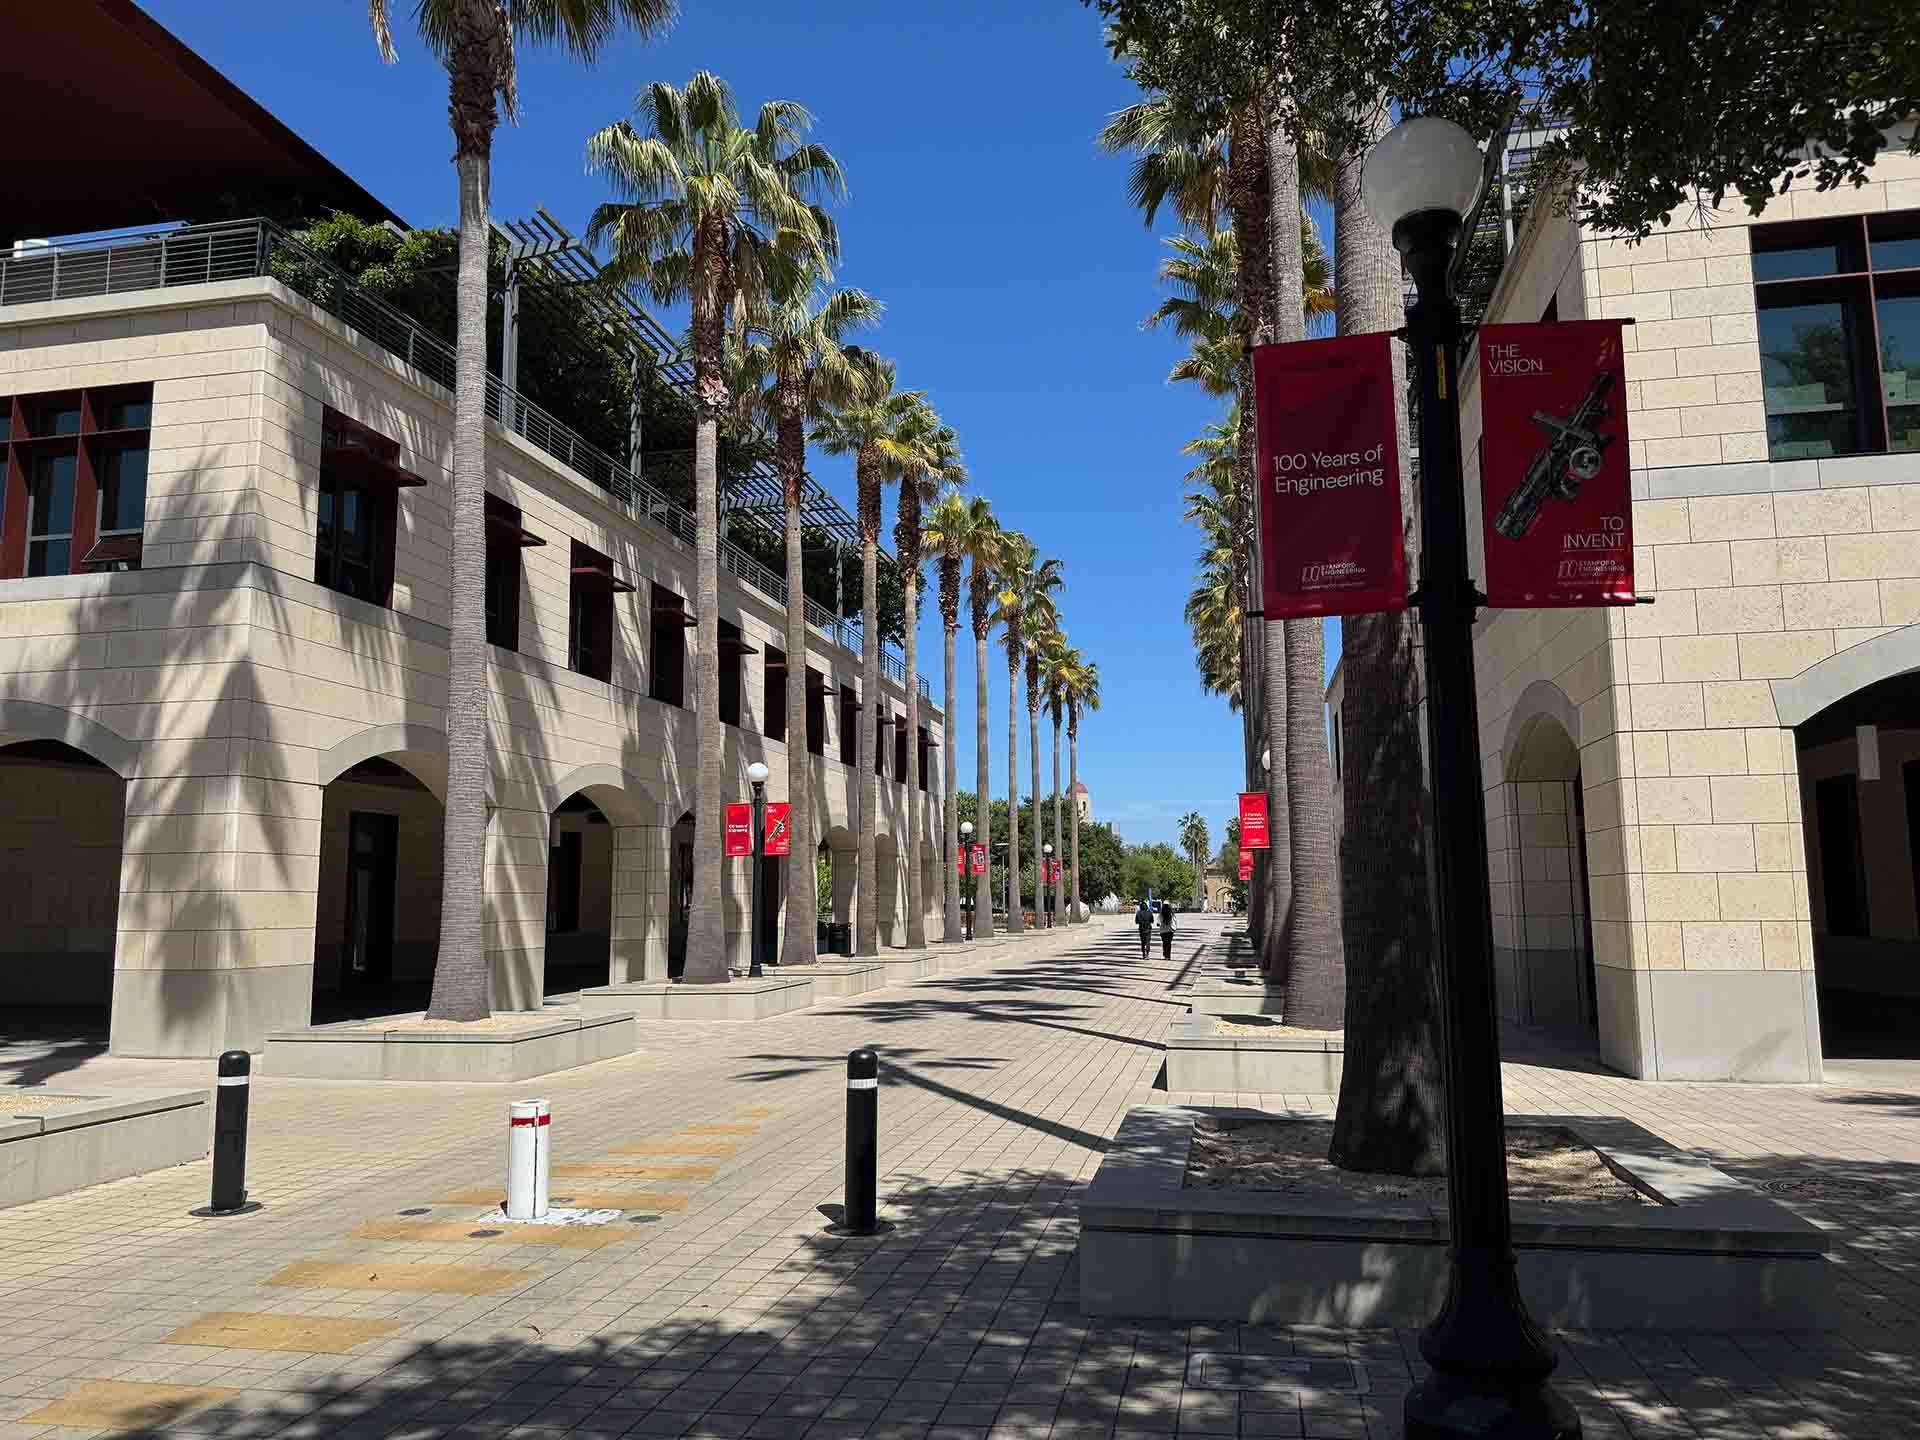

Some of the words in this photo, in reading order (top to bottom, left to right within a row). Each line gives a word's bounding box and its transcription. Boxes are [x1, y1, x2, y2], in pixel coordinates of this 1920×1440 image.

[1488, 344, 1521, 358] THE
[1488, 358, 1543, 374] VISION
[1273, 453, 1307, 473] 100
[1312, 449, 1361, 468] Years
[1364, 443, 1384, 463] of
[1275, 468, 1385, 496] Engineering
[1600, 516, 1624, 531] TO
[1563, 533, 1625, 548] INVENT
